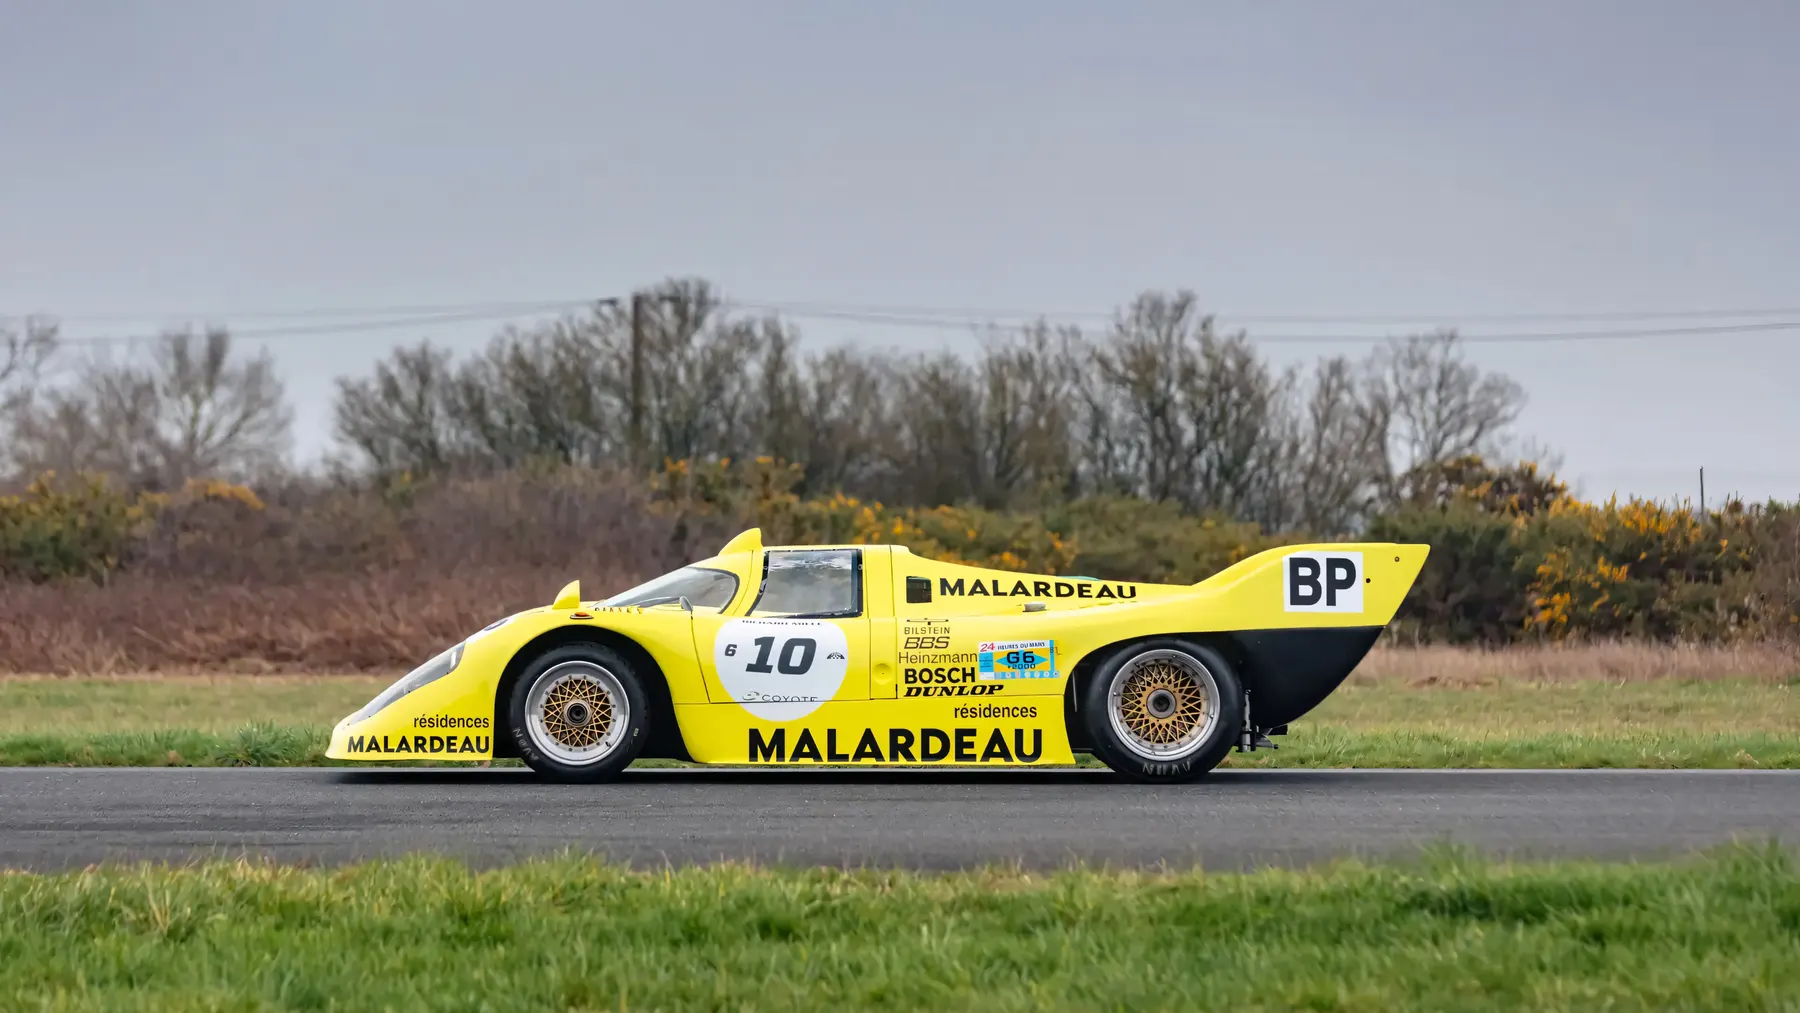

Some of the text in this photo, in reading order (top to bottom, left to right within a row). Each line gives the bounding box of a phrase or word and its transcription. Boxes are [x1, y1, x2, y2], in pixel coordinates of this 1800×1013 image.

[940, 577, 1137, 599] MALARDEAU
[1289, 557, 1356, 606] BP
[904, 636, 950, 649] BBS
[980, 643, 995, 652] 24
[724, 644, 737, 657] 6
[745, 636, 817, 675] 10
[898, 652, 978, 664] Heinzmann
[904, 667, 976, 684] BOSCH
[903, 685, 1004, 697] DUNLOP
[954, 704, 1037, 719] résidences
[414, 714, 490, 728] résidences
[347, 735, 490, 754] MALARDEAU
[748, 728, 1043, 763] MALARDEAU
